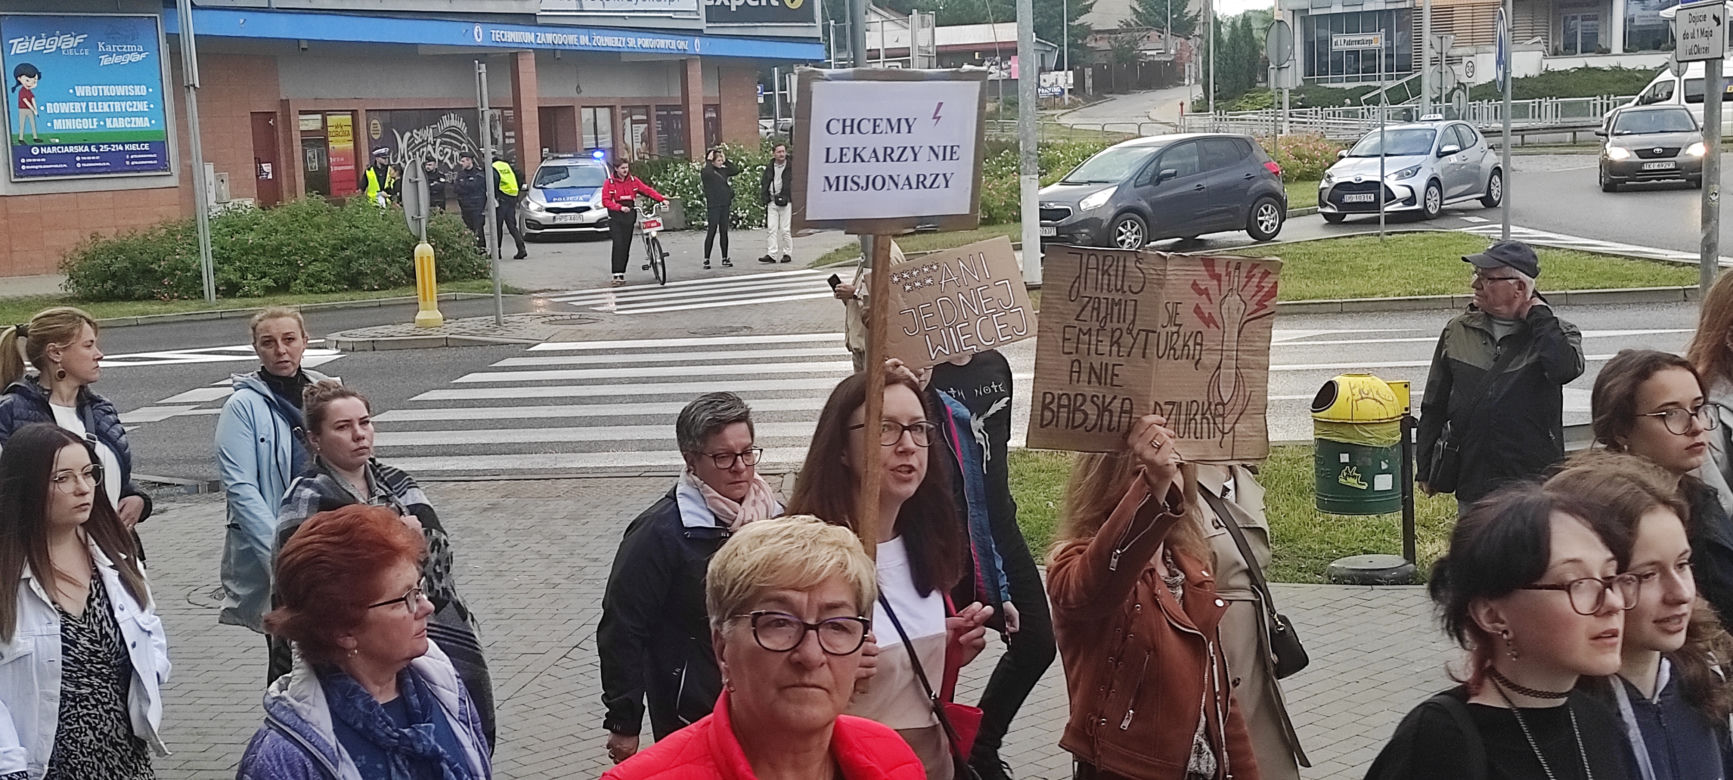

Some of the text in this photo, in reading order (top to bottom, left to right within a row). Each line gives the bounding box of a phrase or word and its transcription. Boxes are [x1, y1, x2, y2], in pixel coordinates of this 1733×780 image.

[97, 42, 143, 52] Karczma
[490, 30, 535, 44] TECHNIKUM
[536, 33, 578, 45] ZAWODOWE
[75, 85, 147, 96] WROTKOWISKO
[46, 101, 149, 114] ROWERY ELEKTRYCZNE
[53, 117, 150, 130] MINIGOLF KARCZMA
[825, 117, 917, 136] CHCEMY
[41, 145, 88, 154] NARCIARSKA
[124, 143, 150, 151] KIELCE
[824, 145, 961, 164] LEKARZY NIE
[822, 172, 956, 193] MISJONARZY
[939, 252, 990, 293] ANI
[1067, 252, 1146, 302] JARUŚ
[899, 279, 1016, 336] JEDNEJ
[1075, 296, 1138, 334] ZAJMIJ
[924, 307, 1028, 360] WIĘCEJ
[1062, 325, 1204, 371] EMERYTURKĄ
[1069, 359, 1124, 387] A NIE
